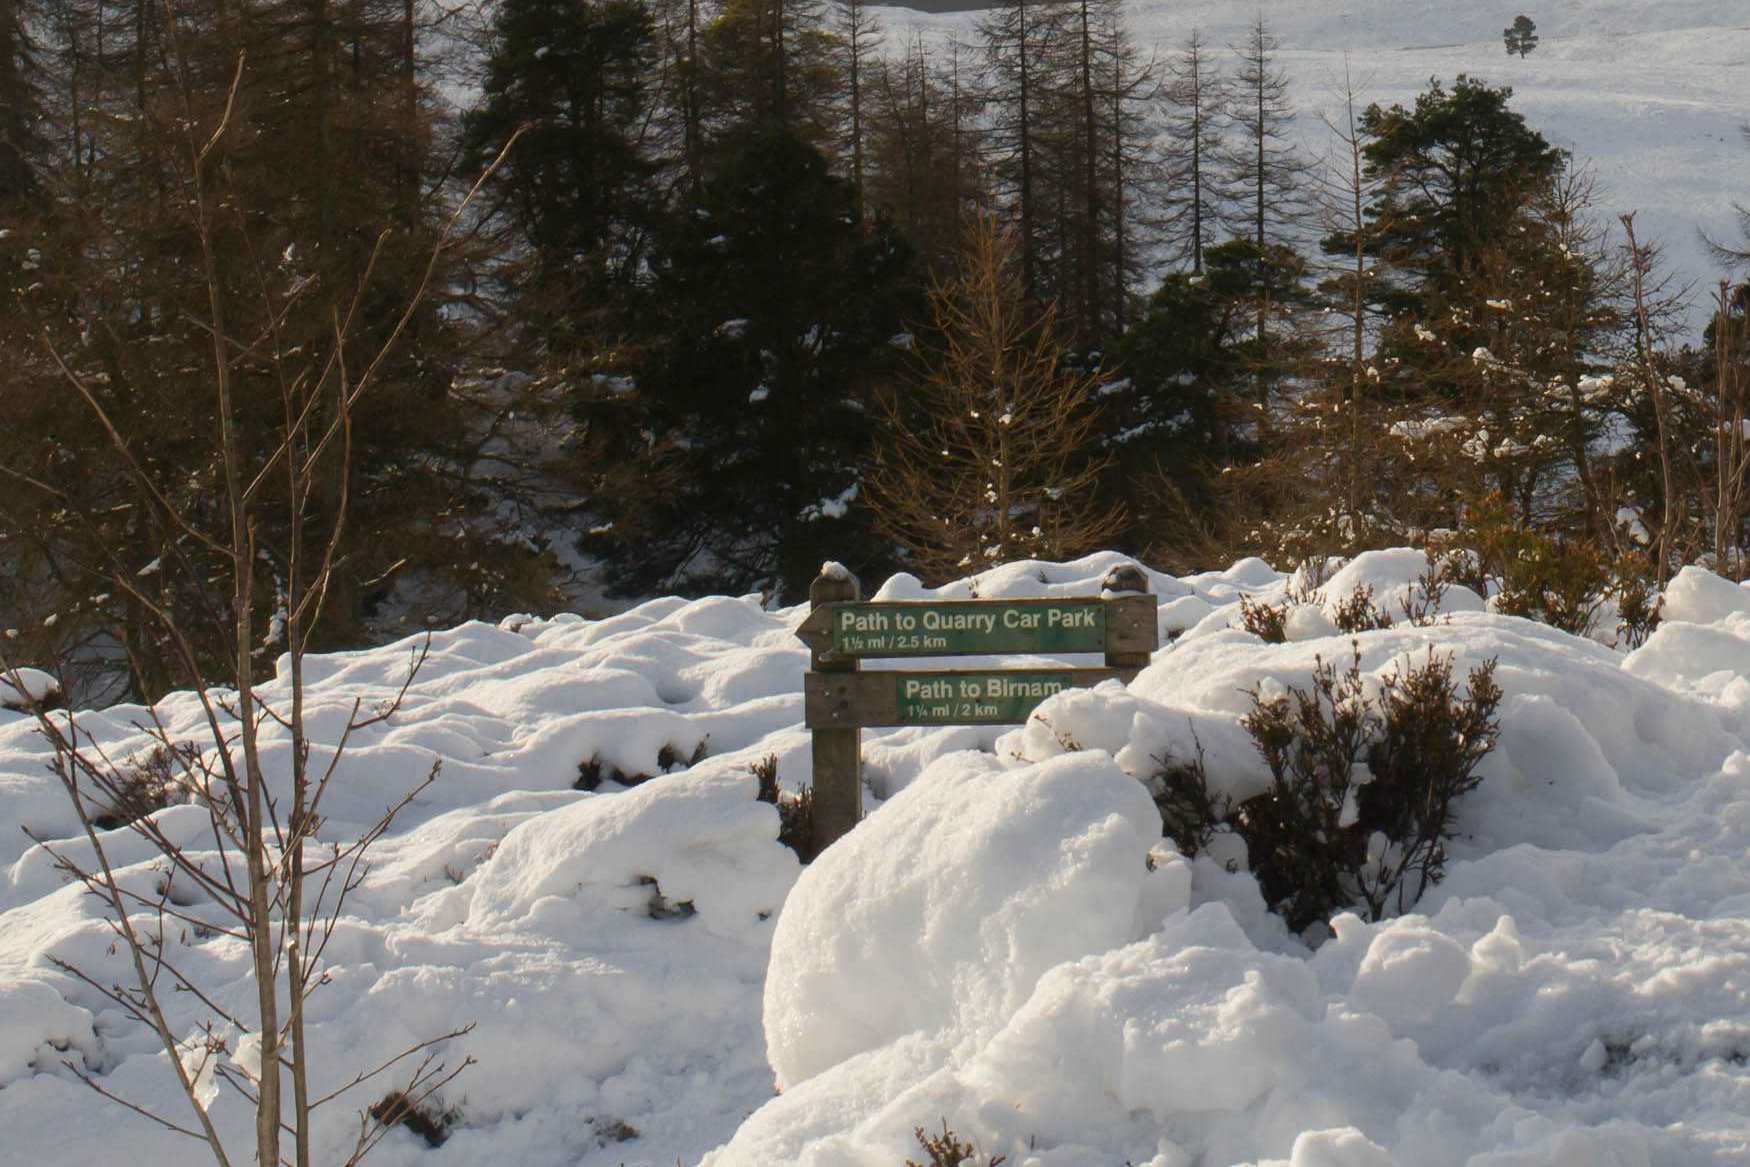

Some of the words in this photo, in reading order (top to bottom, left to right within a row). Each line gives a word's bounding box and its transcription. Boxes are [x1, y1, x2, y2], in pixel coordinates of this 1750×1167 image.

[841, 613, 888, 631] Path
[895, 612, 916, 630] to
[922, 610, 996, 633] Quarry
[1003, 609, 1041, 629] Car
[1048, 608, 1096, 627] Park
[868, 636, 885, 649] ml
[897, 636, 919, 649] 2.5
[923, 634, 947, 648] km
[905, 680, 953, 699] Path
[960, 680, 981, 698] to
[987, 679, 1062, 698] Birnam
[932, 704, 950, 717] ml
[962, 704, 971, 717] 2
[974, 703, 998, 717] km
